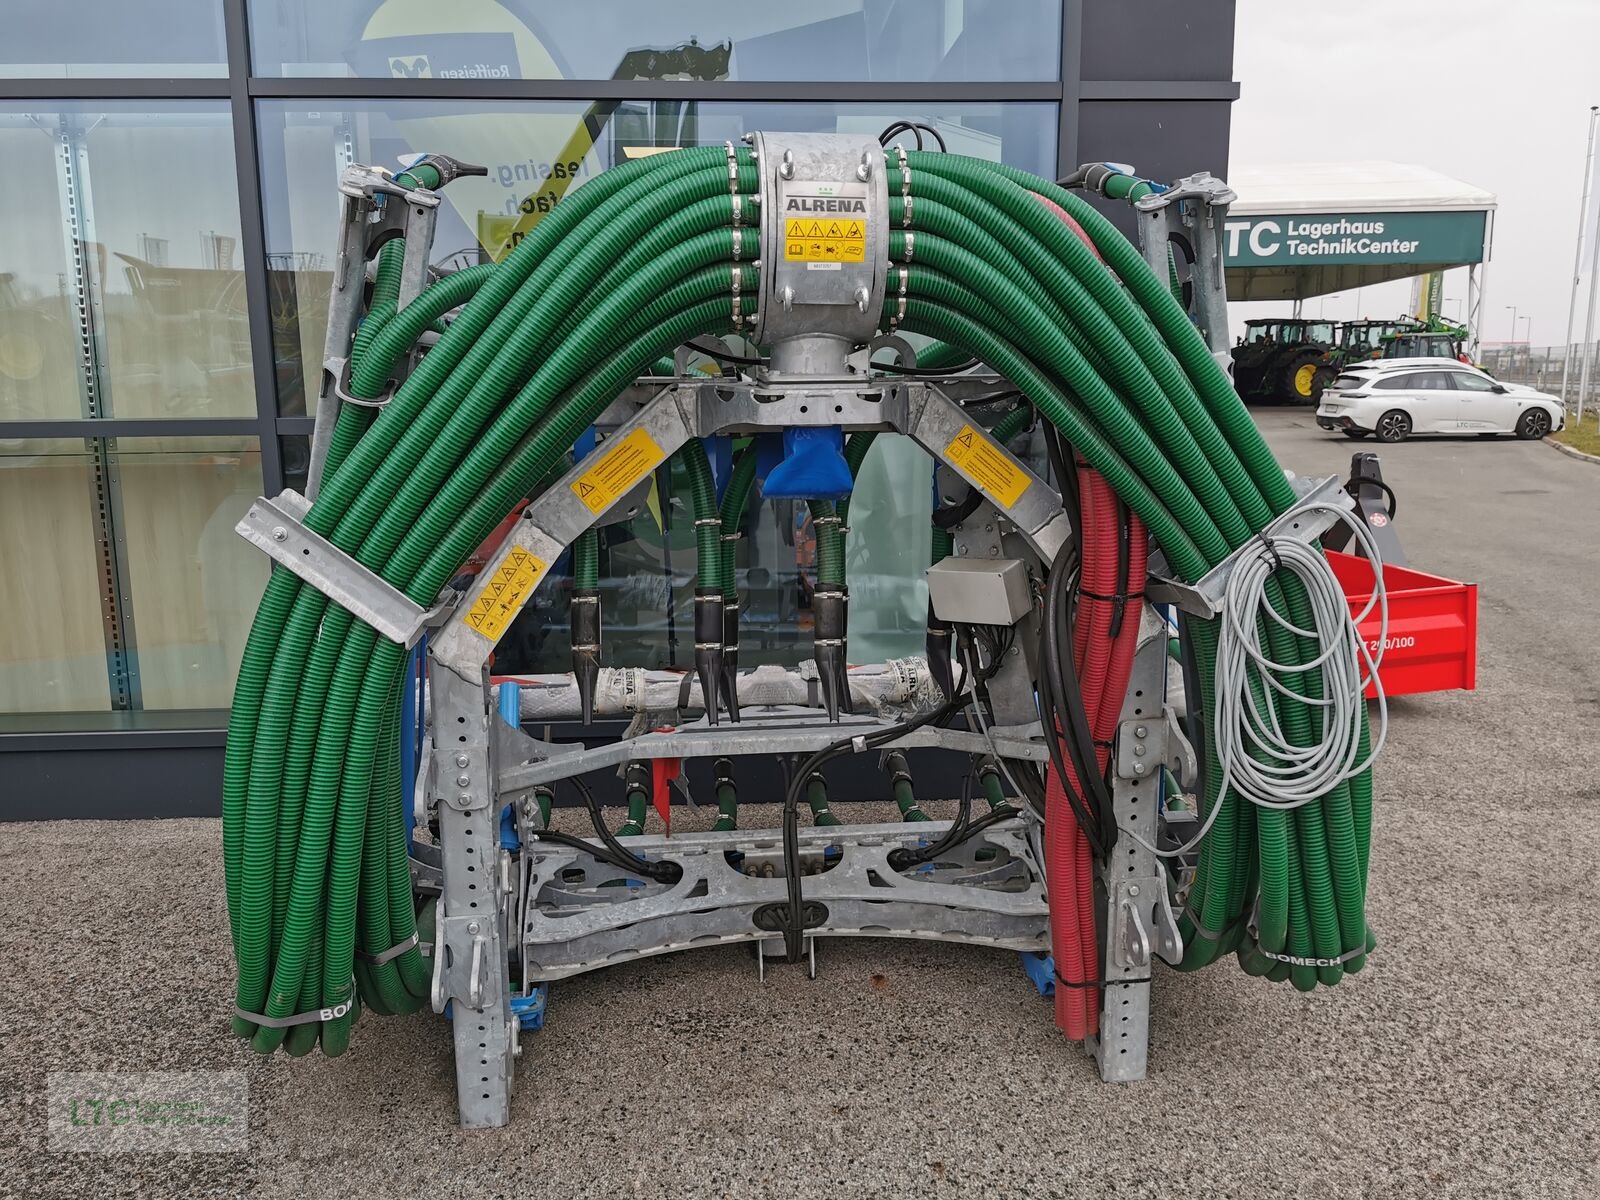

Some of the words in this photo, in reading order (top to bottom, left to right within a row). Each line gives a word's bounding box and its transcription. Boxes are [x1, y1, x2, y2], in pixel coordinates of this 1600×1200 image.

[787, 199, 866, 213] ALRENA
[1287, 219, 1385, 239] Lagerhaus
[1224, 220, 1282, 257] TC
[1286, 238, 1419, 256] TechnikCenter
[1370, 636, 1415, 651] 20/100
[1265, 951, 1341, 967] BOMECH
